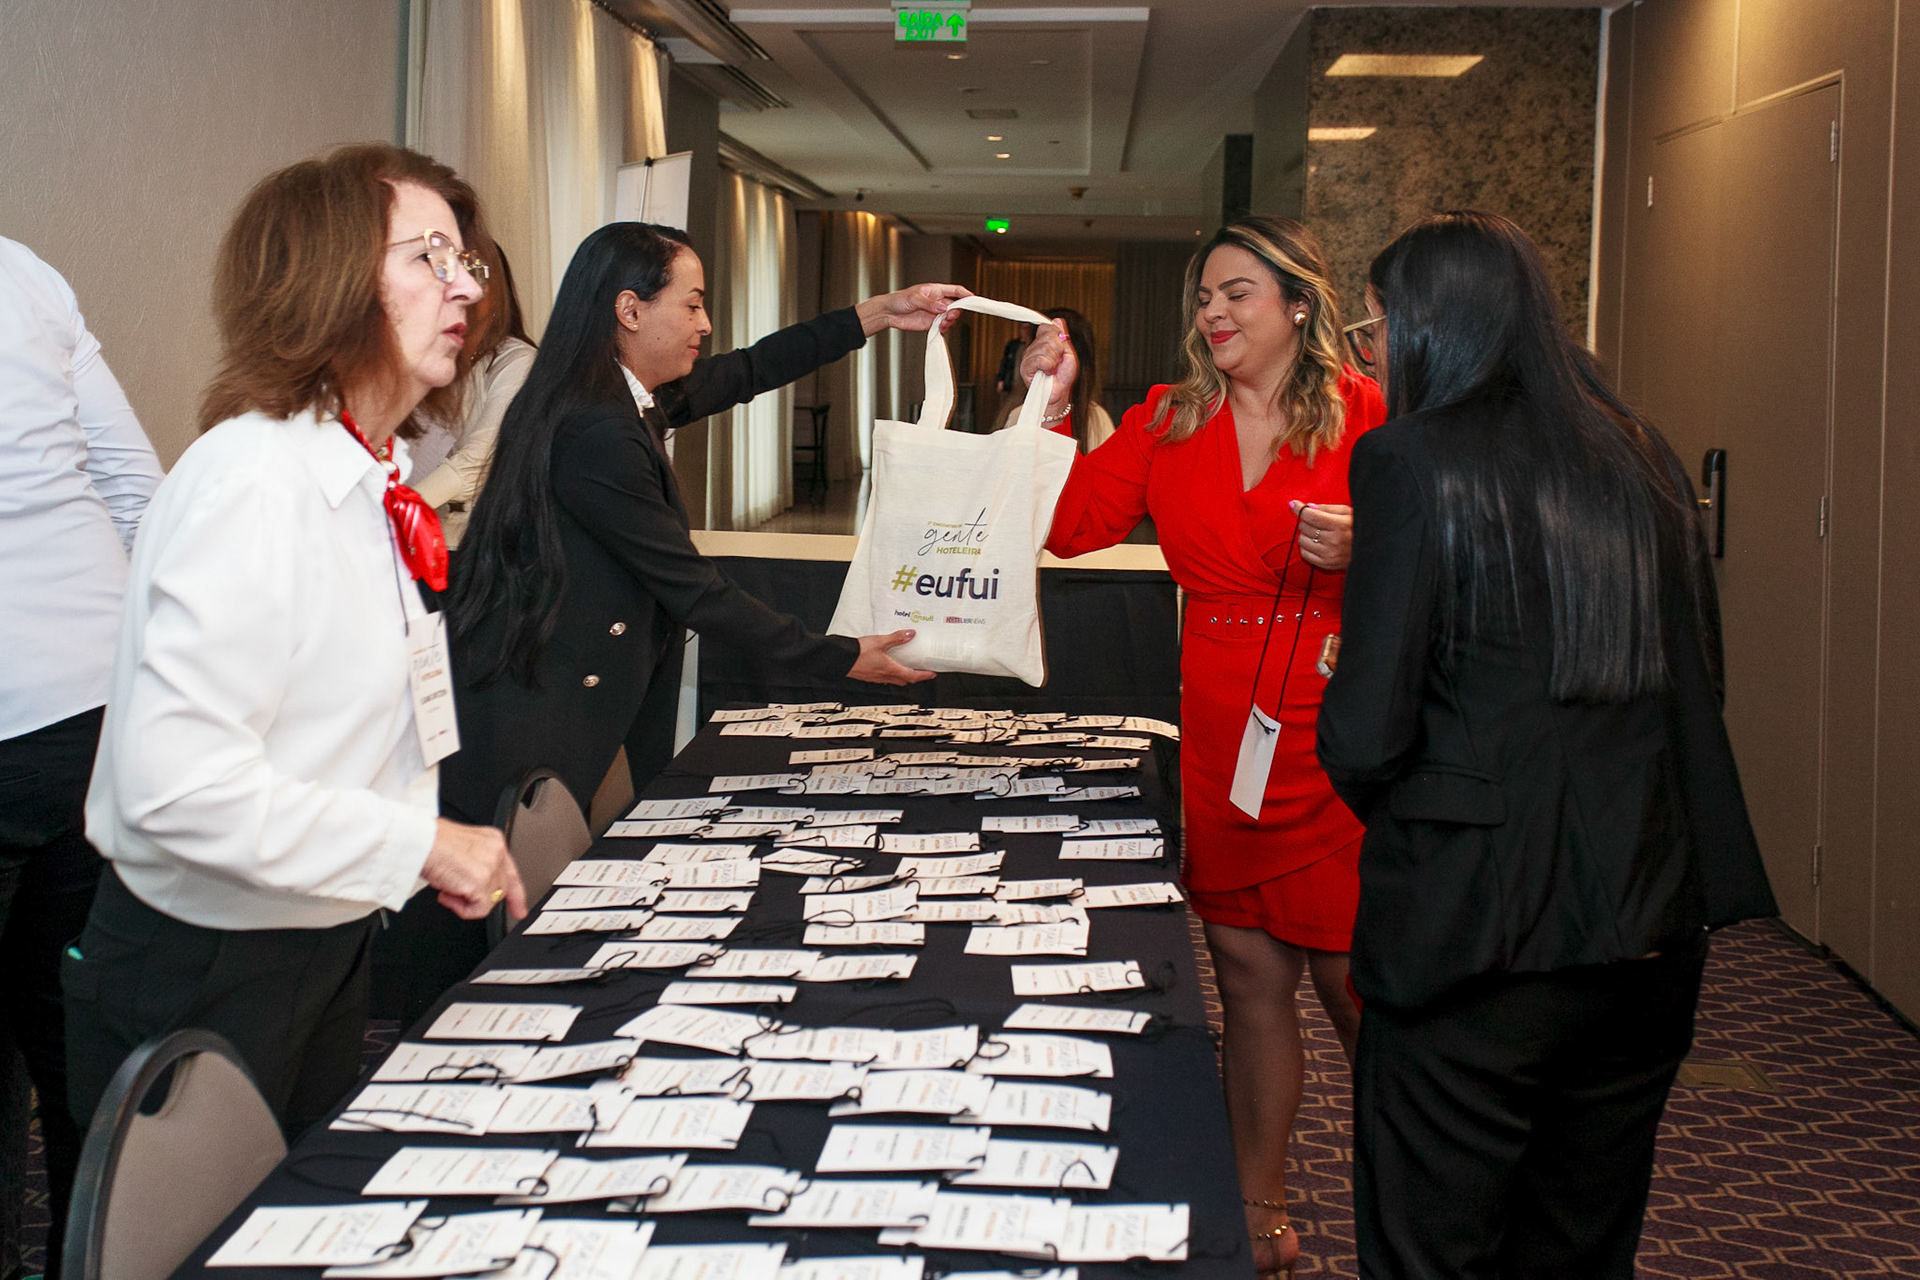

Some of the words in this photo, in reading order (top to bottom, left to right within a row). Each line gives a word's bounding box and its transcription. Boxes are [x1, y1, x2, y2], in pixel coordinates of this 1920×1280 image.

[905, 25, 938, 41] EXIT
[917, 507, 990, 556] gente
[936, 547, 981, 556] HOTELEIRA
[891, 564, 1000, 600] #eufui
